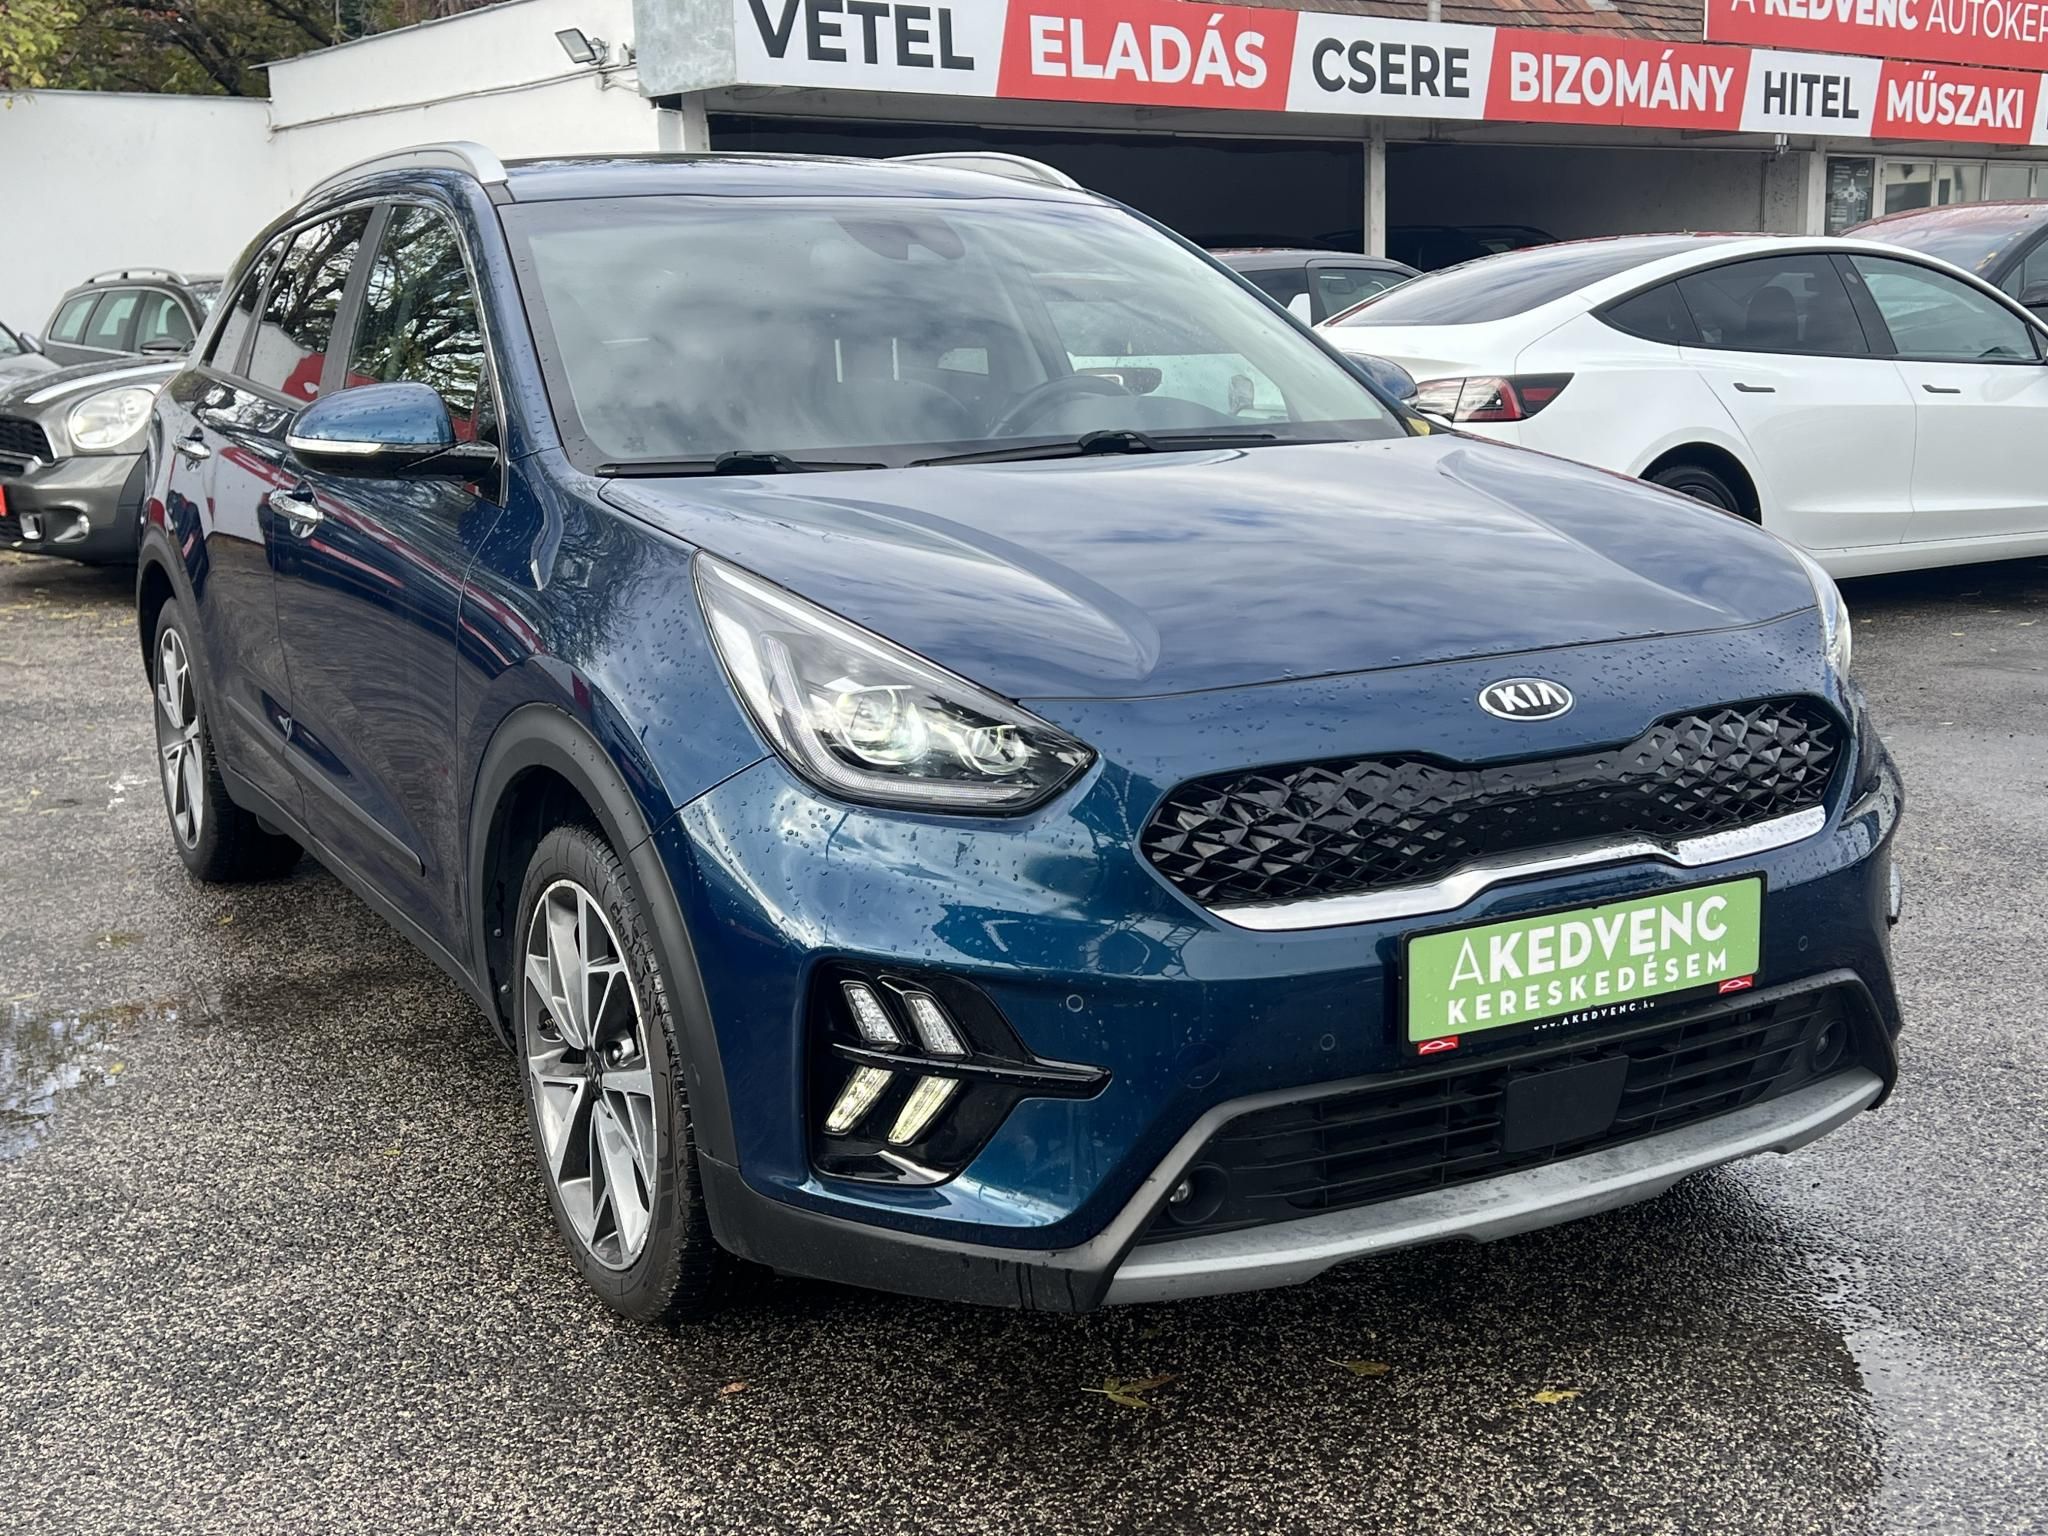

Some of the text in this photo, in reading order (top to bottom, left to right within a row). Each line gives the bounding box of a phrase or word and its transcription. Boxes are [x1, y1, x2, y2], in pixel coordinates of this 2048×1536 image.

[1029, 13, 1267, 89] ELADÁS
[1311, 37, 1469, 99] CSERE
[1510, 49, 1734, 112] BIZOMÁNY
[1763, 70, 1859, 120] HITEL
[1886, 70, 2024, 129] MŰSZAKI
[1491, 682, 1566, 712] KIA
[1448, 948, 1727, 1026] KERESKEDÉSEM
